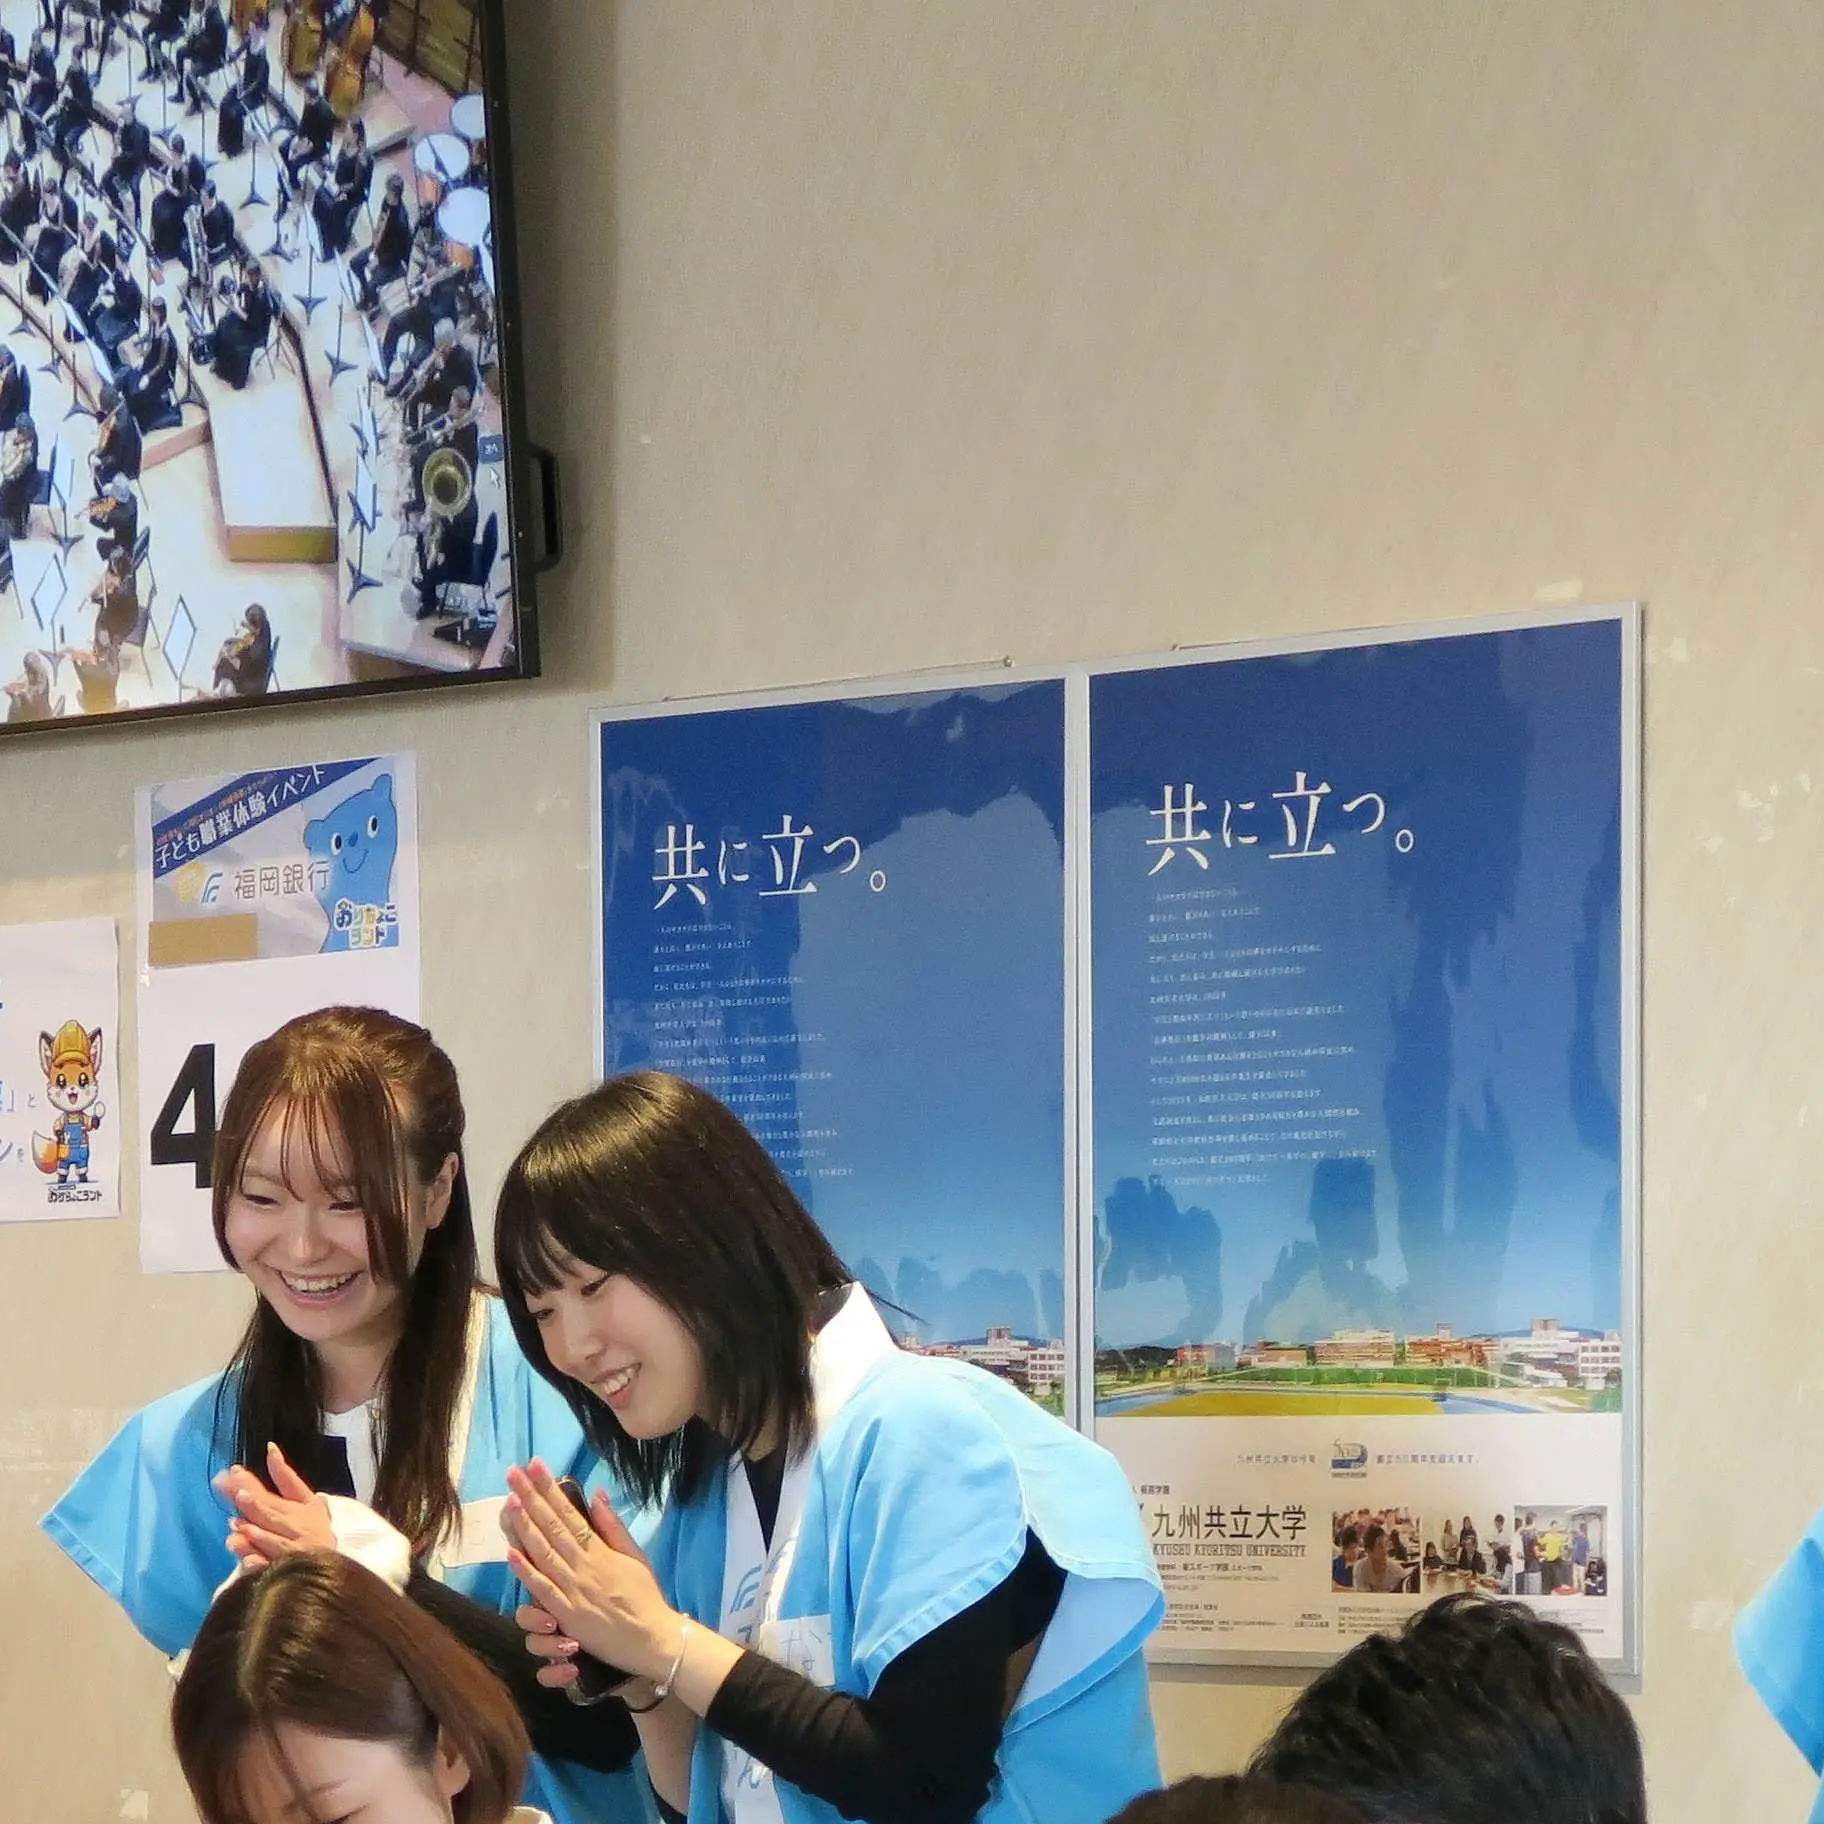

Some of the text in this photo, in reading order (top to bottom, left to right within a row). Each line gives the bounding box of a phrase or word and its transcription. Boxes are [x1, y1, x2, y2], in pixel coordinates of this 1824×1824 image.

[1146, 770, 1414, 876] 共に立つ。
[234, 861, 329, 900] 福岡銀行
[653, 815, 887, 910] 共に立つ。
[1152, 1504, 1307, 1541] 九州共立大学
